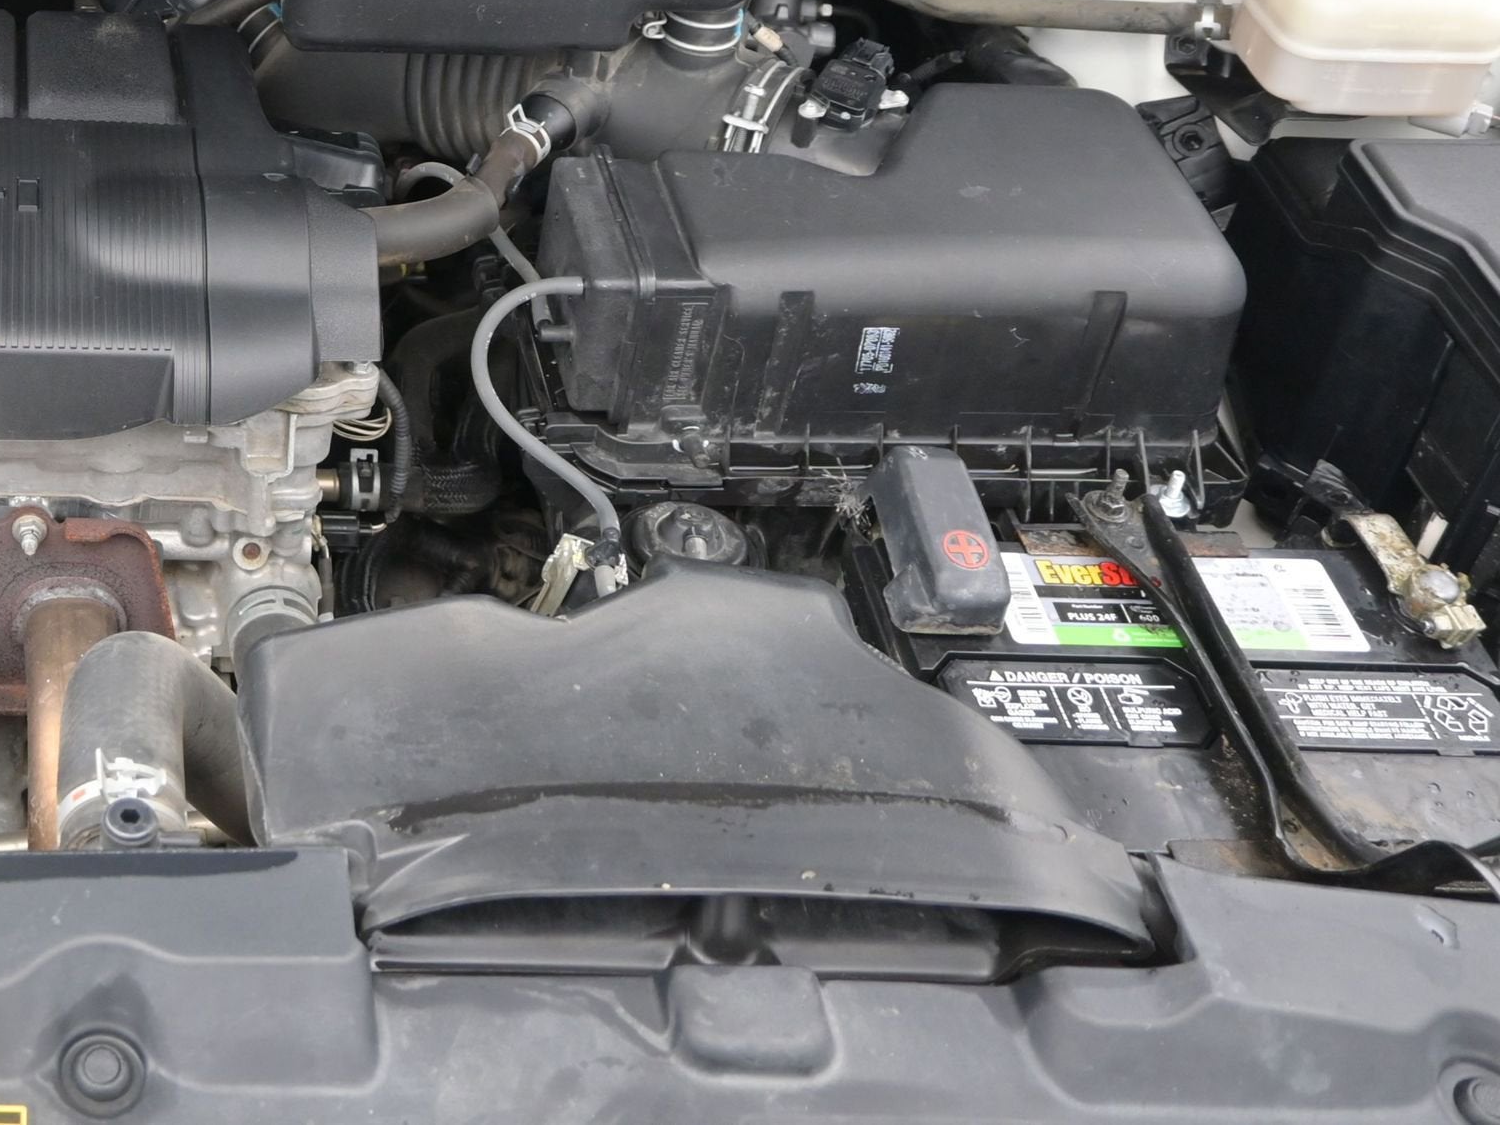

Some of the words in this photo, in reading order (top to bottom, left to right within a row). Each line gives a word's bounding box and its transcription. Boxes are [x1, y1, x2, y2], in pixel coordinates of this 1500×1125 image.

[1066, 611, 1096, 622] PLUS
[1096, 612, 1118, 622] 24F
[1004, 671, 1070, 684] DANGER
[1083, 673, 1143, 685] POISON
